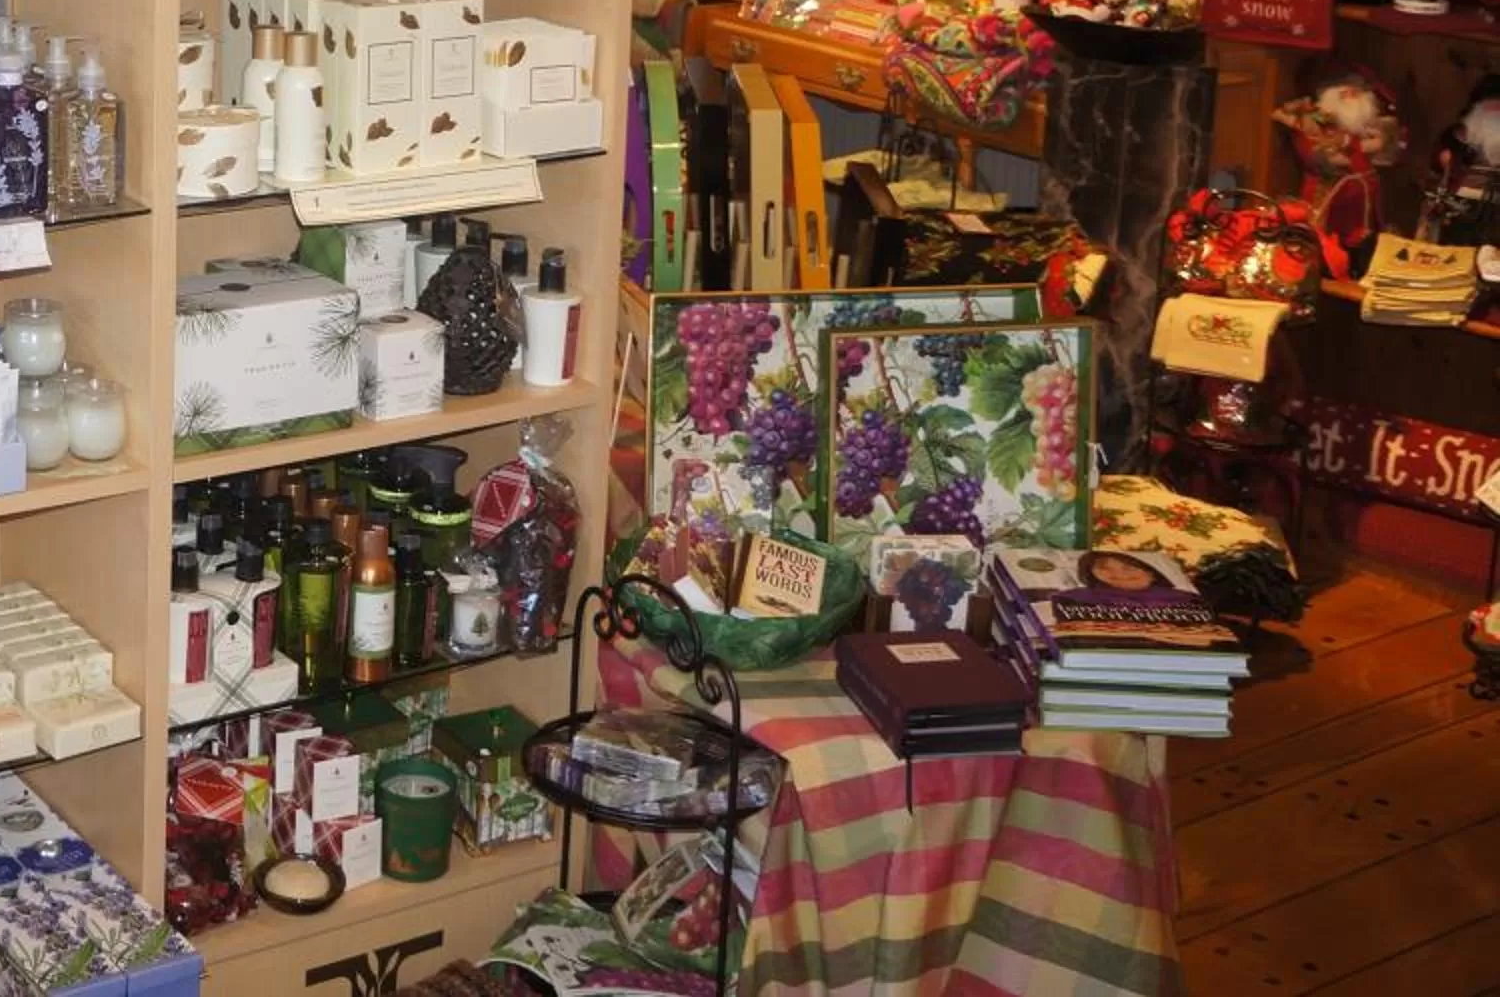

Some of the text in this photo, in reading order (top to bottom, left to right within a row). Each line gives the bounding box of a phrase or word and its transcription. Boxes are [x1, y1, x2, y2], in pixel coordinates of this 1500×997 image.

[1241, 1, 1294, 21] snow
[1293, 419, 1500, 505] et It Sn
[759, 540, 819, 572] FAMOUS
[759, 554, 817, 583] LAST
[756, 566, 813, 599] WORDS
